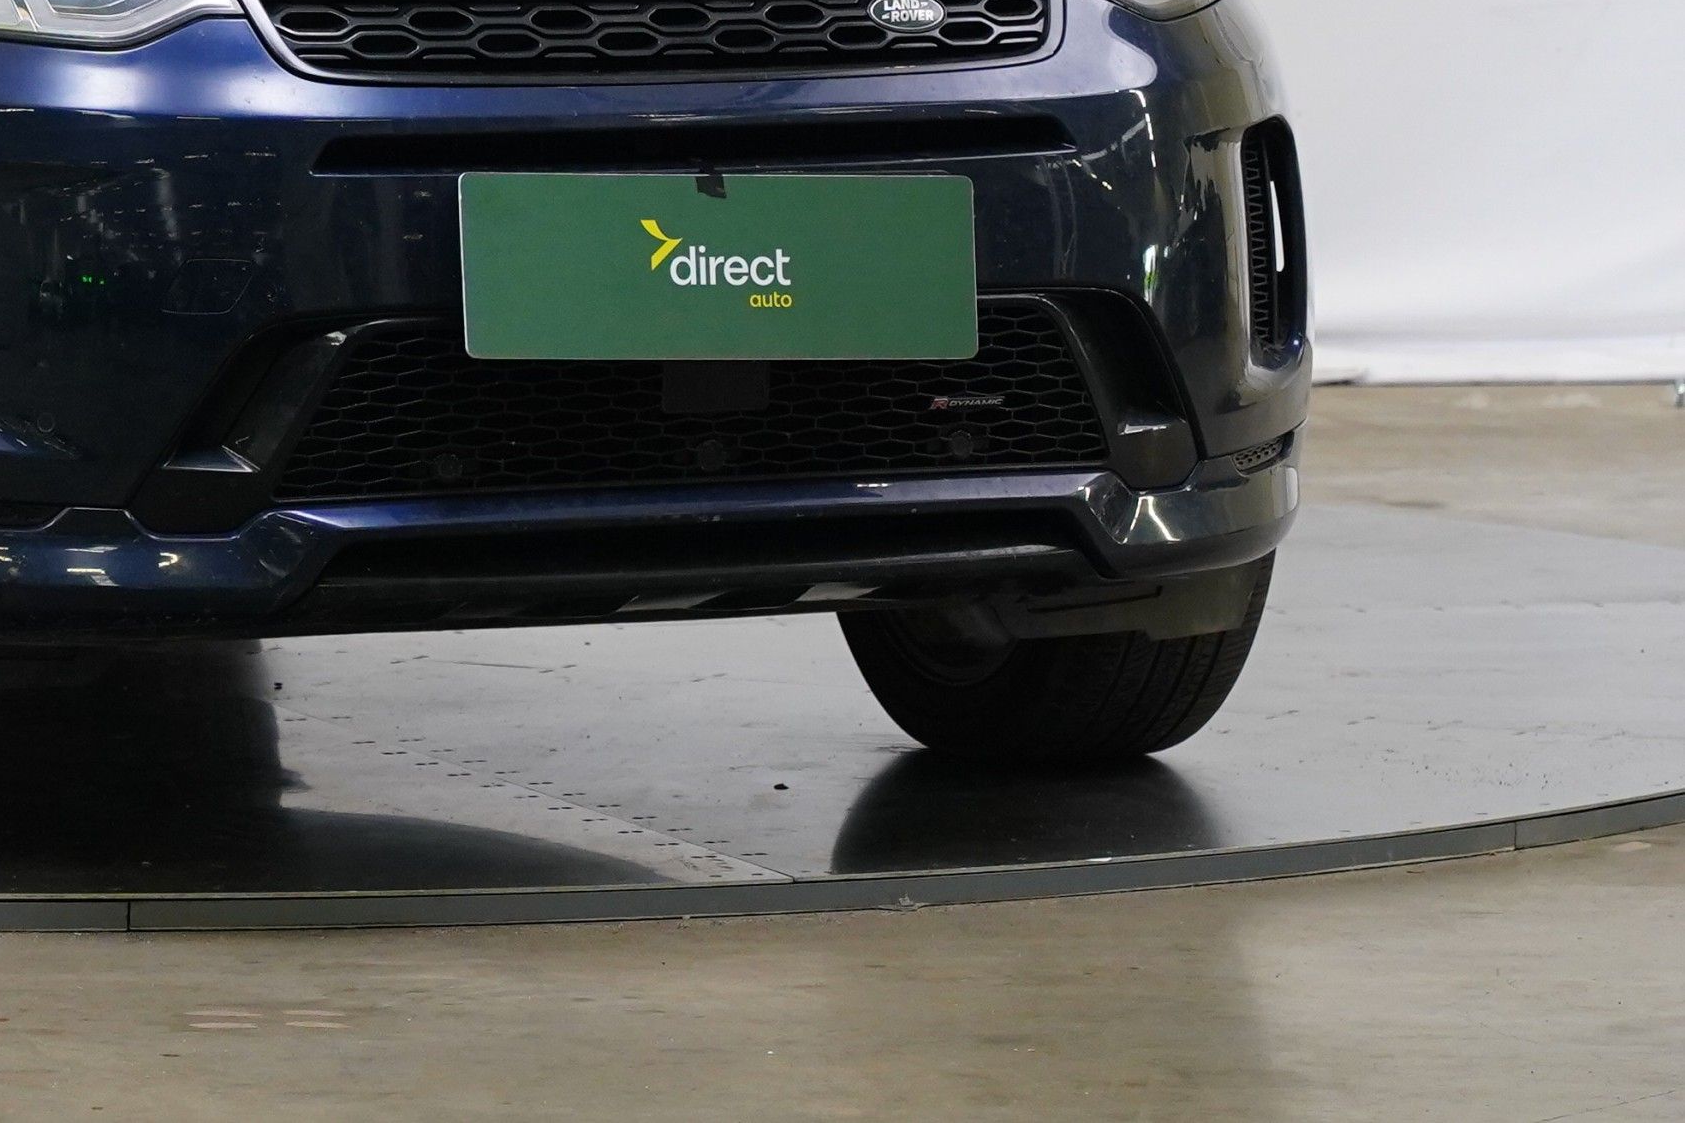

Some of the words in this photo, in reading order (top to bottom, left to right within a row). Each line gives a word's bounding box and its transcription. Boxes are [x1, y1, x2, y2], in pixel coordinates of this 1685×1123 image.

[883, 0, 920, 12] LAND
[890, 9, 935, 22] ROVER
[669, 245, 792, 286] direct
[749, 291, 793, 308] auto
